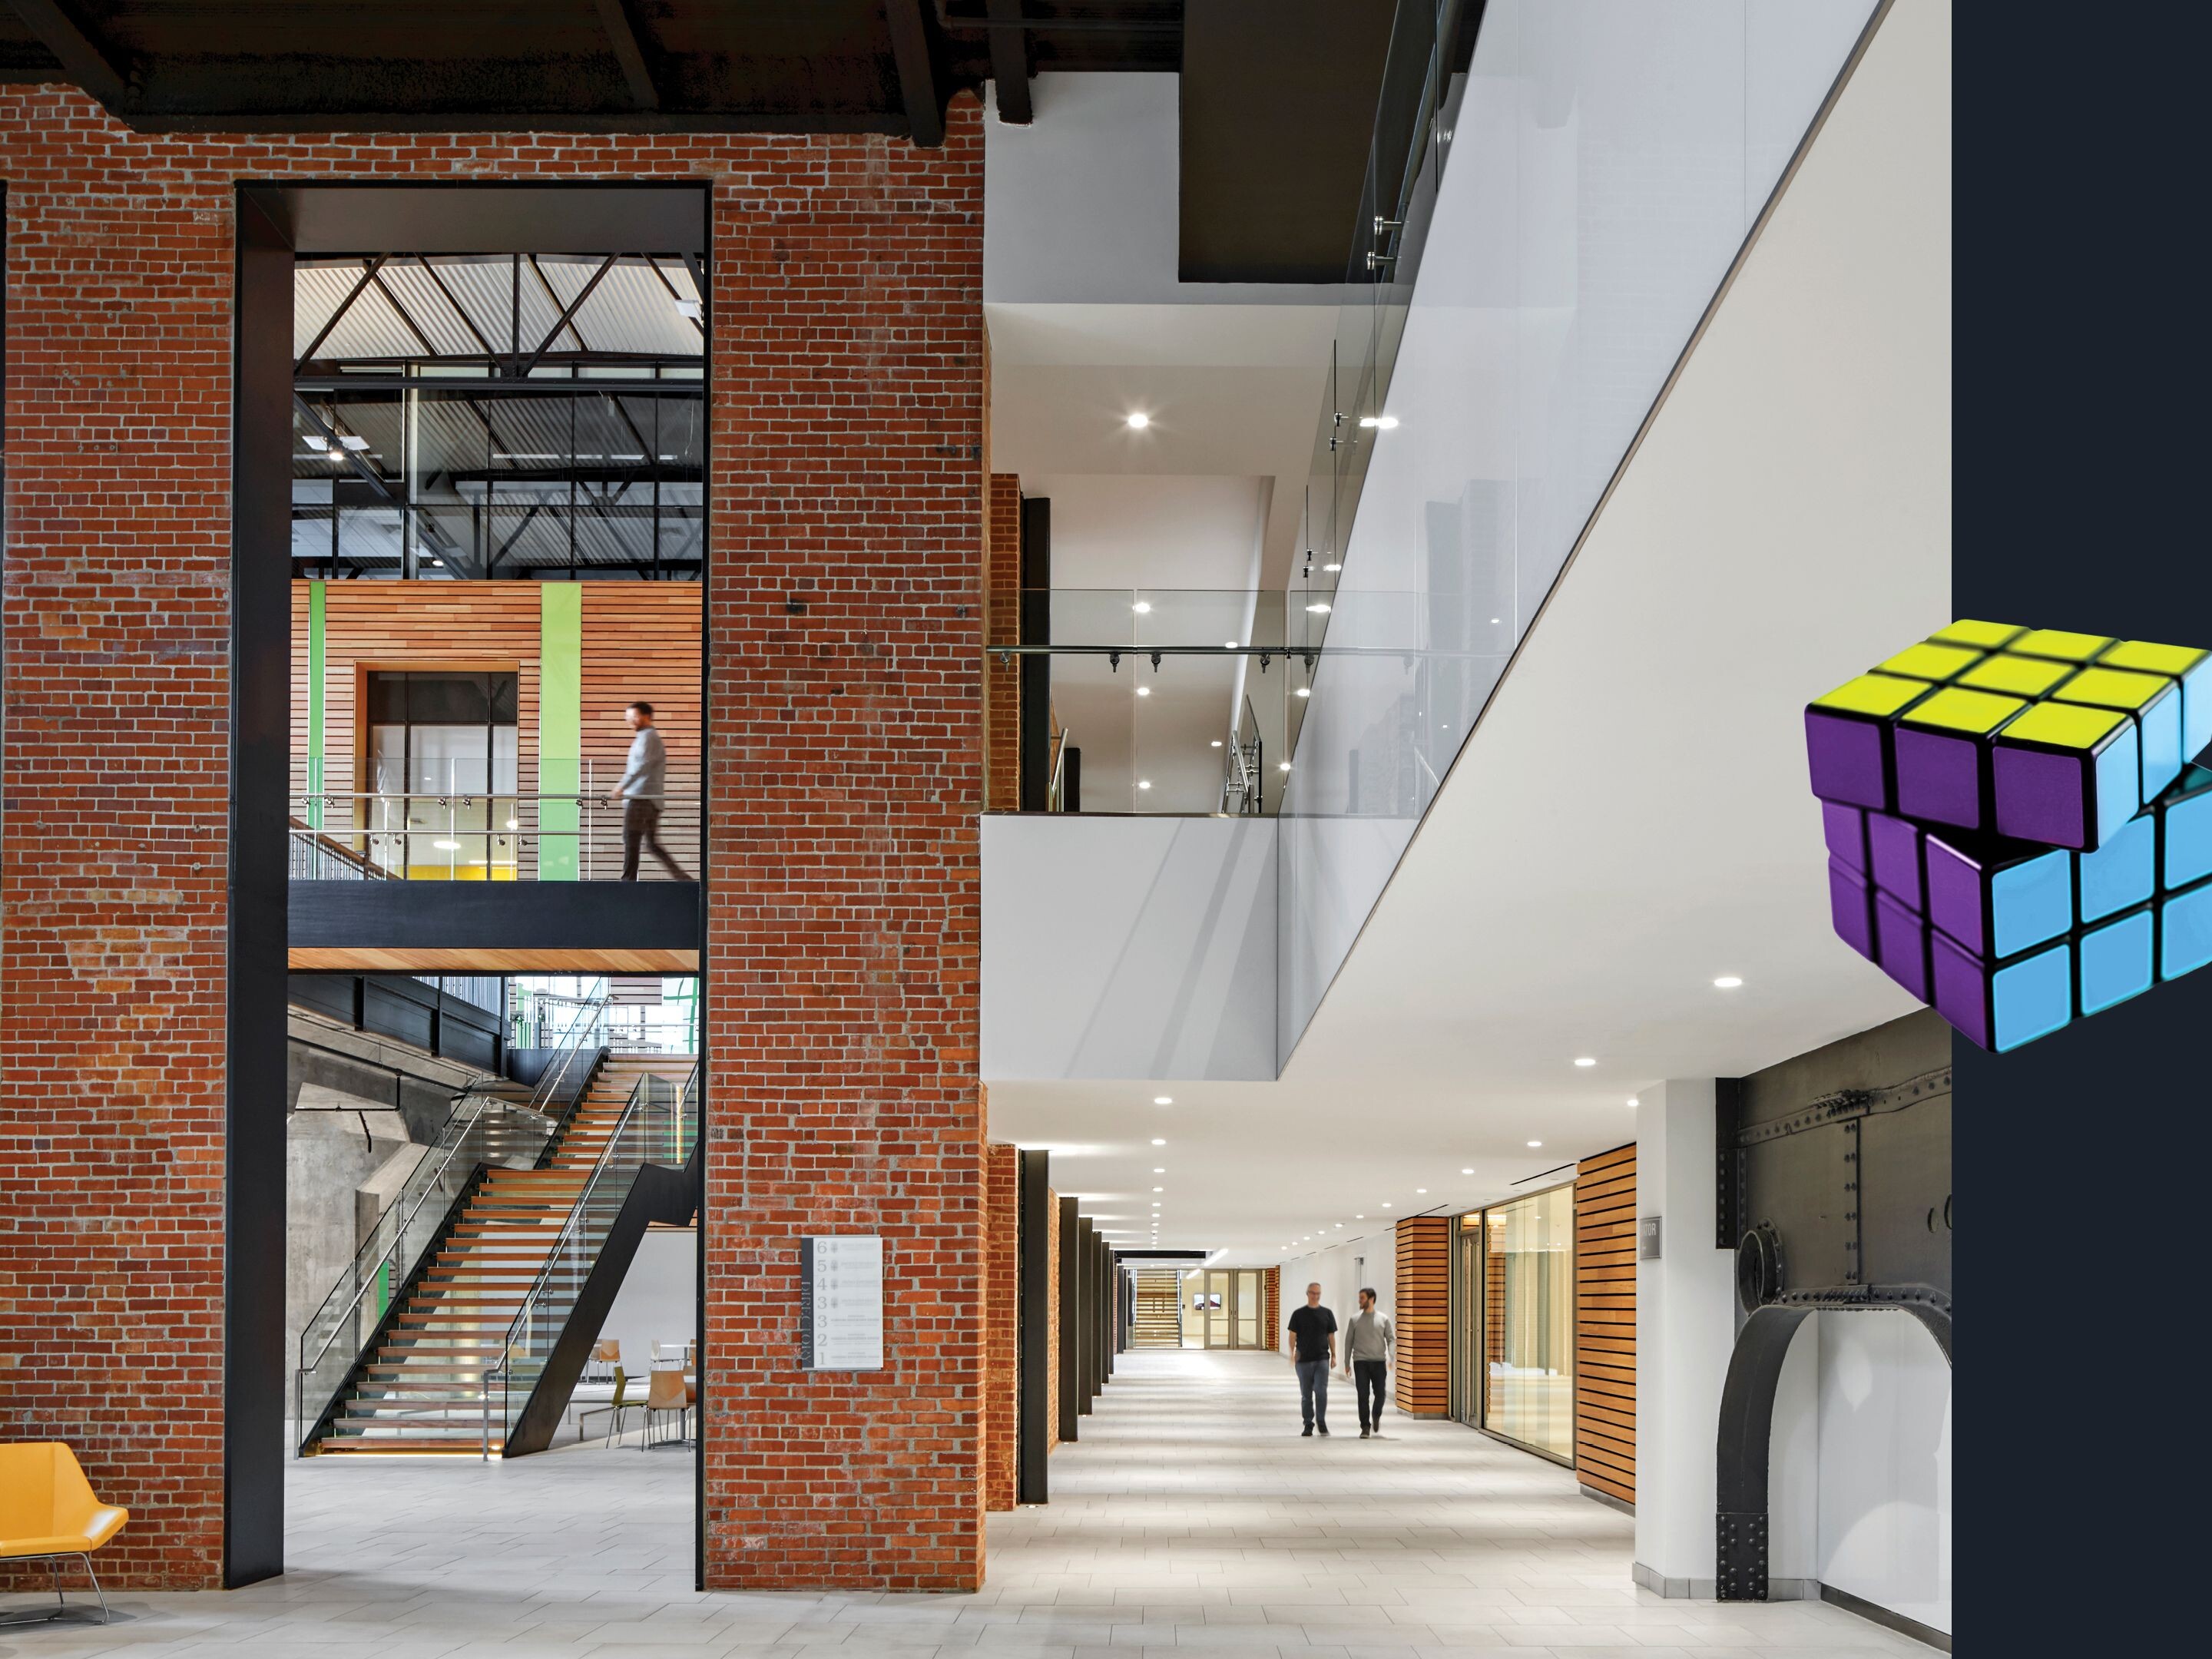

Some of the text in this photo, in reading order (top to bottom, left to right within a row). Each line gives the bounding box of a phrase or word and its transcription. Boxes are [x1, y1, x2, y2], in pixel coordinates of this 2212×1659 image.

[817, 1241, 827, 1253] 6
[817, 1260, 827, 1272] 5
[817, 1278, 827, 1290] 4
[817, 1296, 827, 1309] 3
[802, 1282, 811, 1363] DIRECTORY
[817, 1315, 827, 1327] 3
[817, 1333, 827, 1346] 2
[820, 1353, 824, 1365] 1
